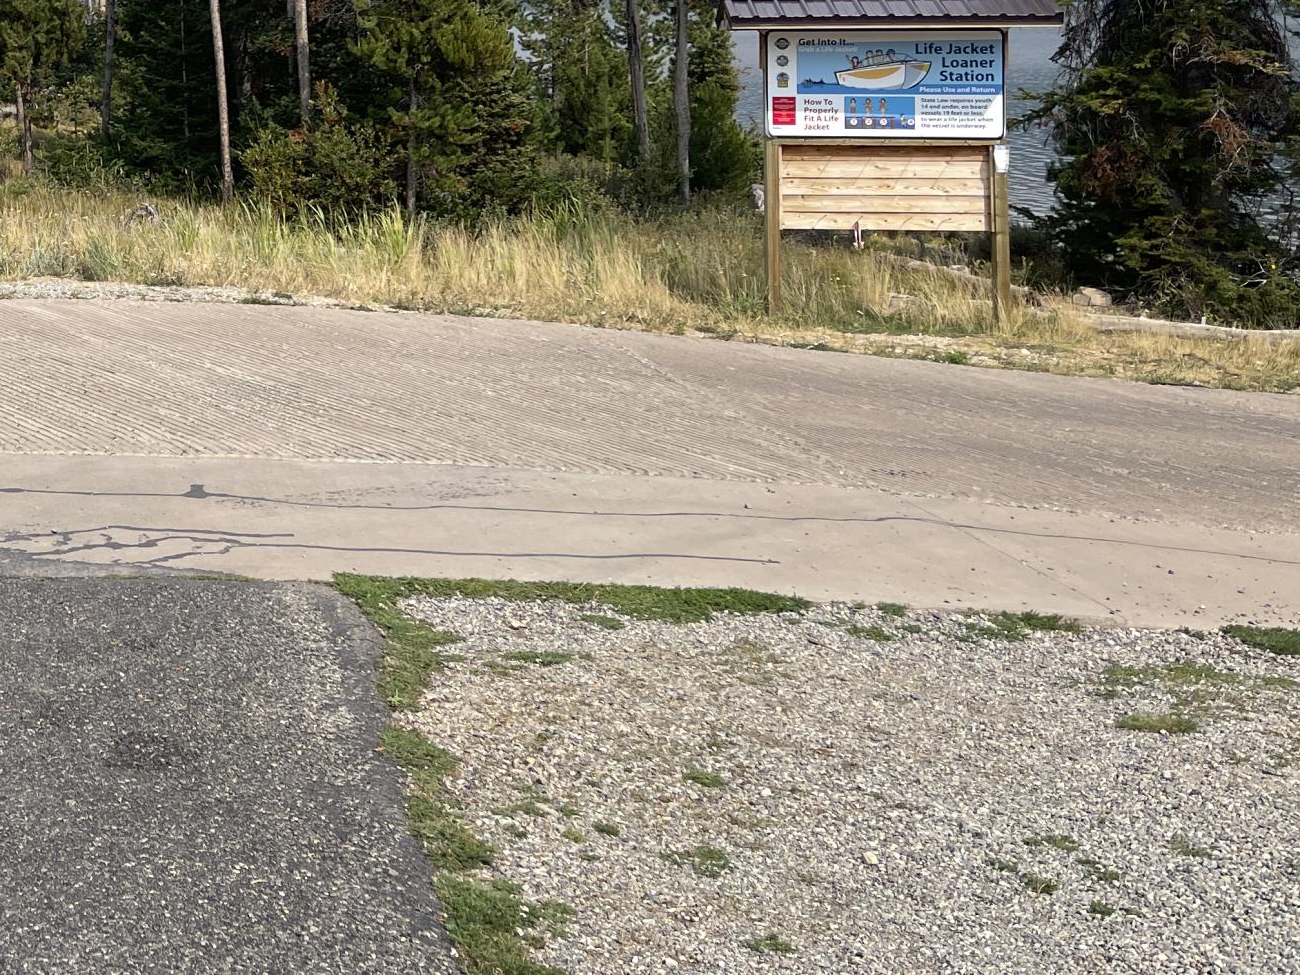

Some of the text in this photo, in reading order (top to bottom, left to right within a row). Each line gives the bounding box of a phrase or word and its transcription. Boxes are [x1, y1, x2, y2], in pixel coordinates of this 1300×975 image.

[798, 38, 815, 46] Get
[817, 38, 837, 46] Into
[915, 43, 995, 54] Life Jacket
[941, 56, 995, 68] Loaner
[939, 70, 995, 82] Station
[803, 107, 839, 115] Properly
[803, 123, 830, 131] Jacket
